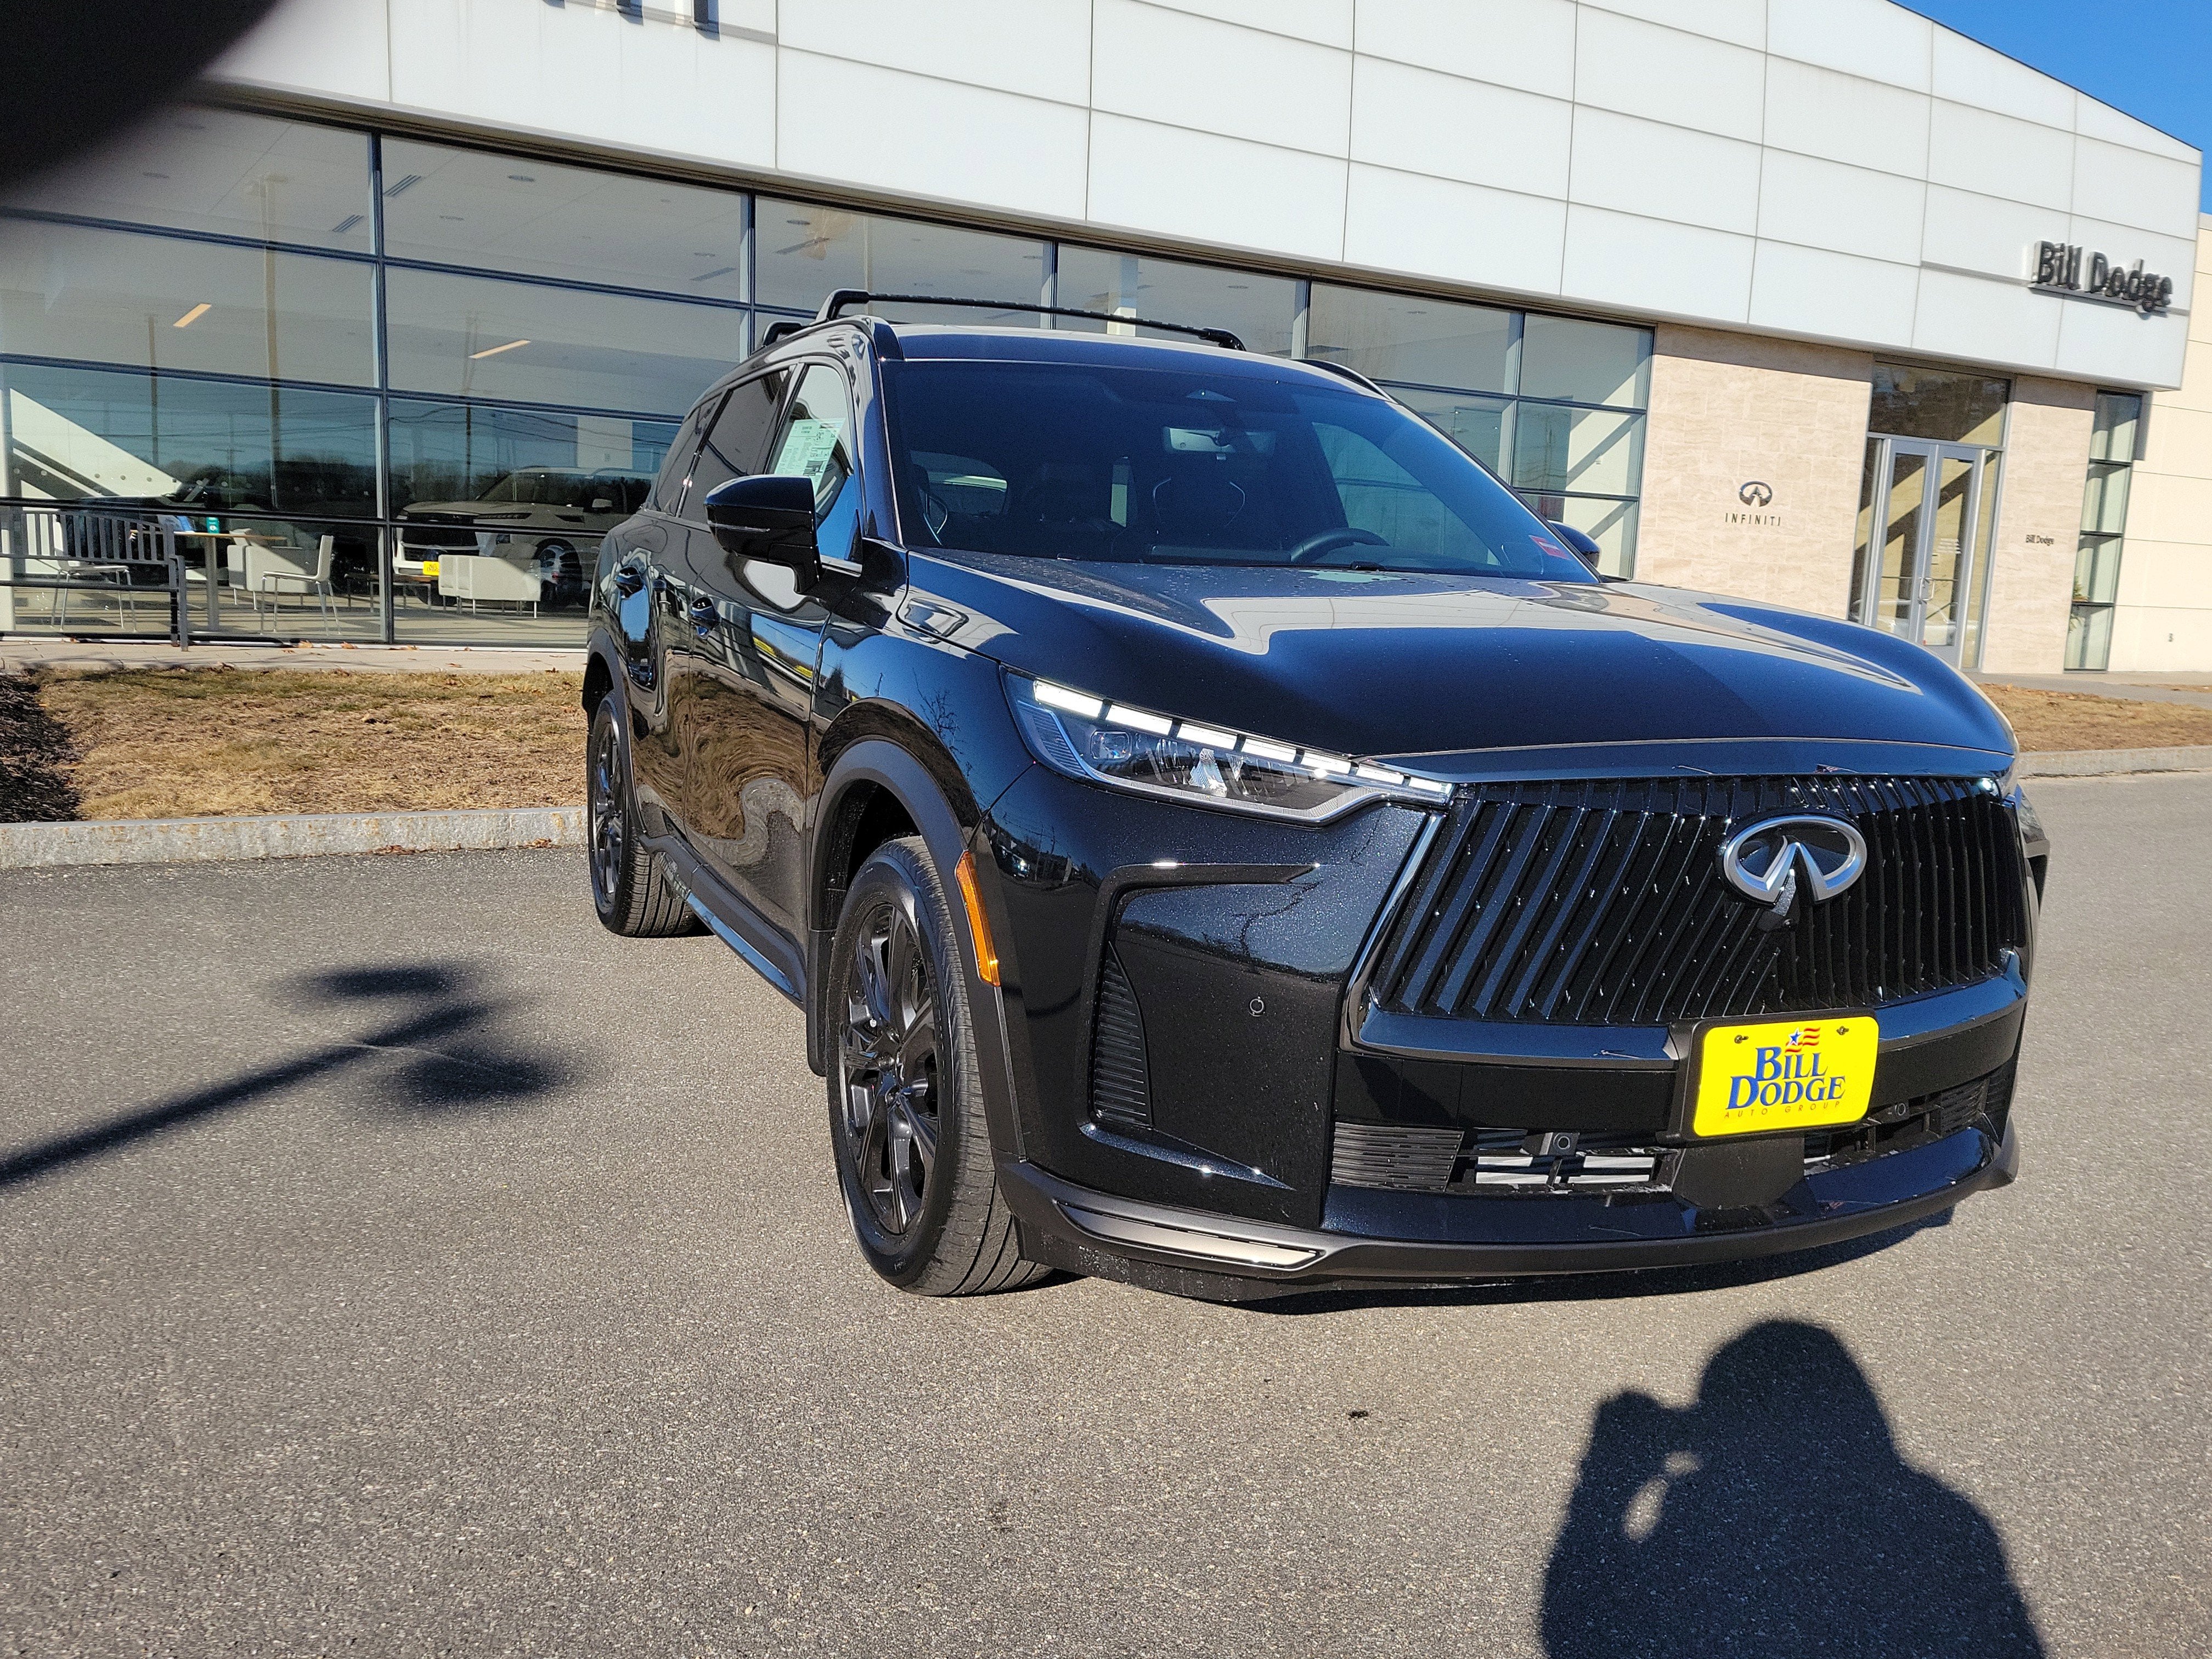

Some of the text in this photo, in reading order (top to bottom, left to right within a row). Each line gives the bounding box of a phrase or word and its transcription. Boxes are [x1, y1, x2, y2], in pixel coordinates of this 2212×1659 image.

[2032, 240, 2173, 312] Bill Dodge
[1725, 512, 1781, 526] INFINITI
[1755, 1046, 1828, 1082] BILL
[1724, 1101, 1841, 1119] AUTO GROUP
[1725, 1075, 1846, 1110] DODGE
